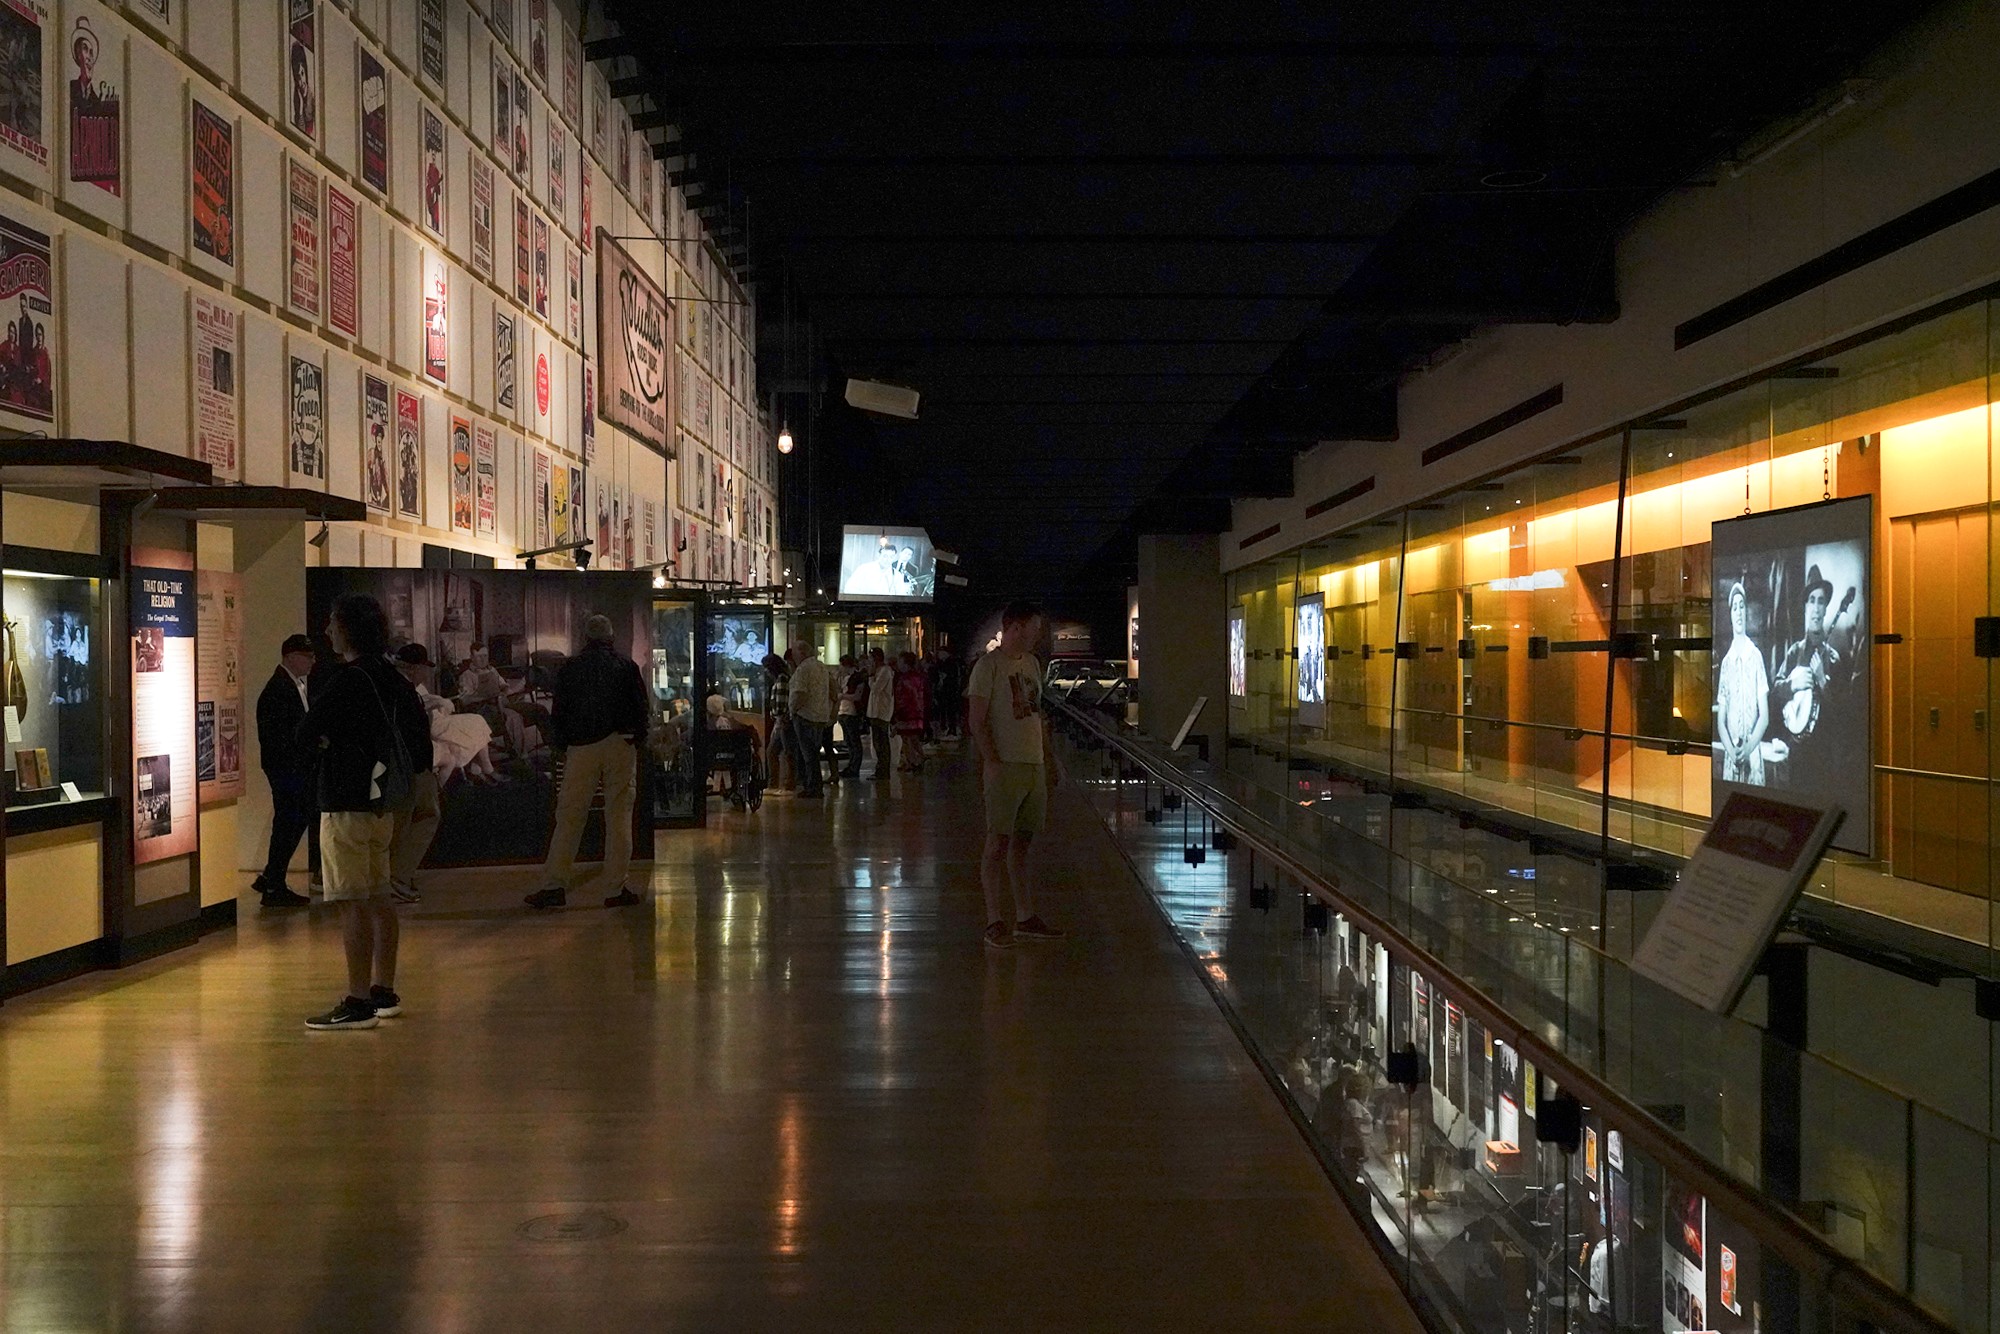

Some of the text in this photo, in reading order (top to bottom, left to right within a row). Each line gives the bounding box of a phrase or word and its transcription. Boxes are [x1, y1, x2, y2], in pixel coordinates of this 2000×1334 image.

[0, 122, 48, 160] ANK SNOW
[293, 223, 318, 253] SNOW
[0, 259, 46, 295] CARTER
[297, 395, 319, 426] Green
[143, 579, 157, 593] THAT
[151, 595, 176, 608] RELIGION
[154, 614, 164, 623] Gospel
[165, 614, 180, 622] Tradition
